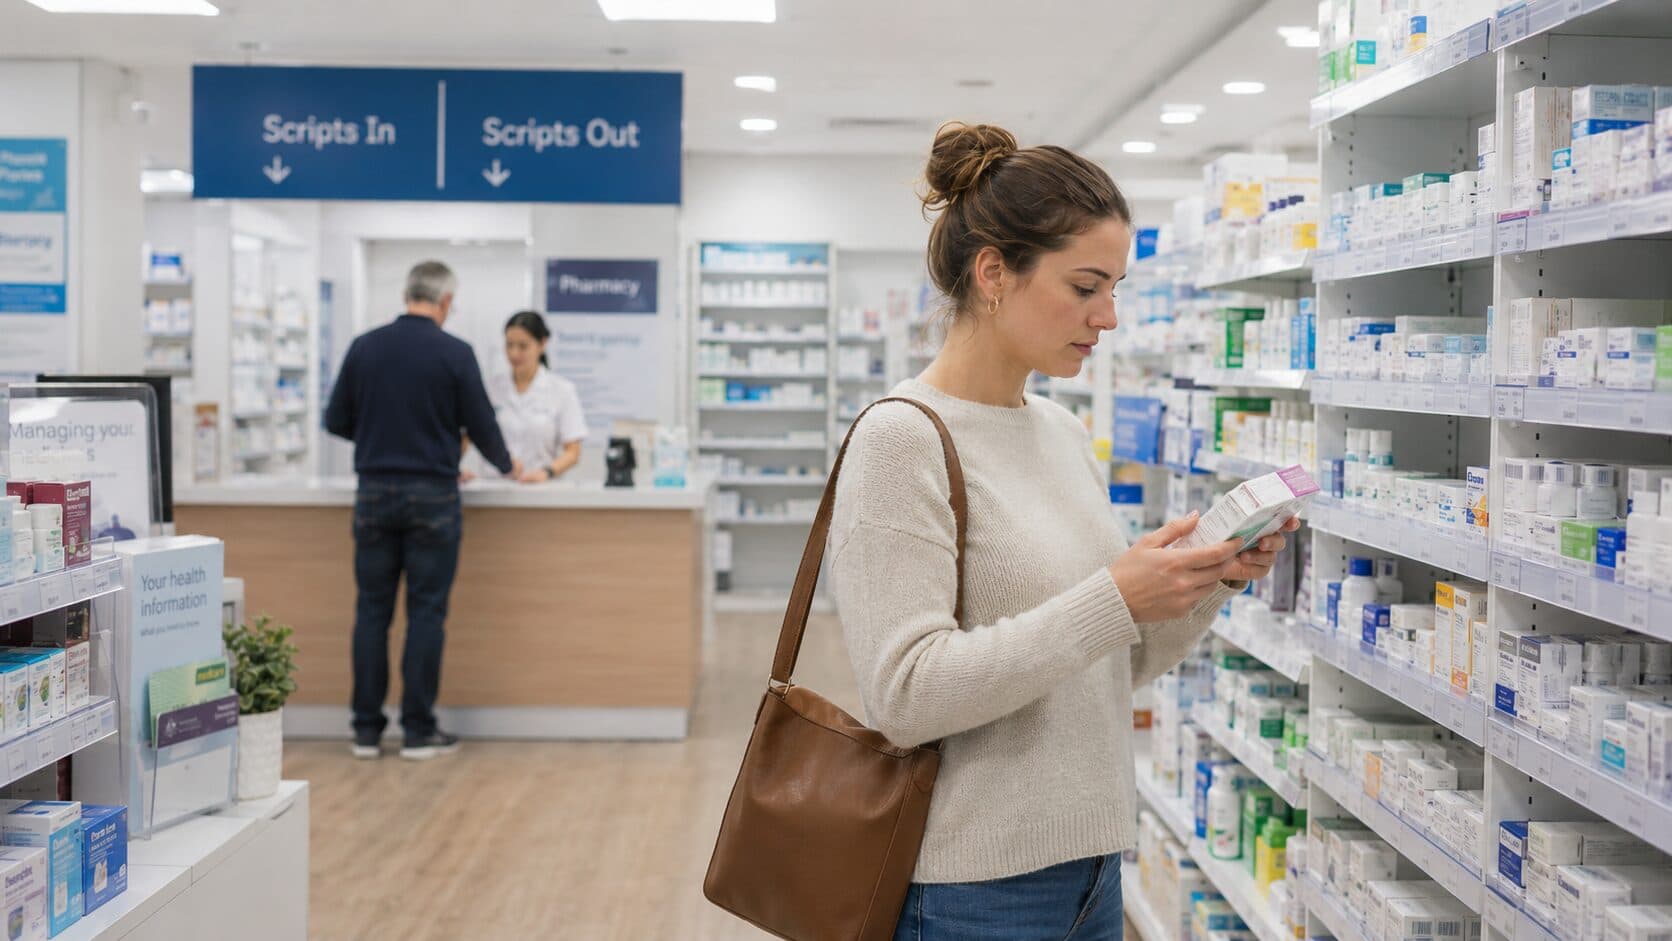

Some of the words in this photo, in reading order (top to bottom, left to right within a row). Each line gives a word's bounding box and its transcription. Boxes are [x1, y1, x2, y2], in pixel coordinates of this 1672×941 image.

[262, 114, 359, 150] Scripts
[365, 115, 396, 145] In
[482, 116, 580, 152] Scripts
[586, 118, 640, 148] Out
[560, 274, 640, 298] Pharmacy
[10, 422, 95, 443] Managing
[141, 575, 166, 591] Your
[170, 566, 206, 587] health
[141, 593, 207, 616] information
